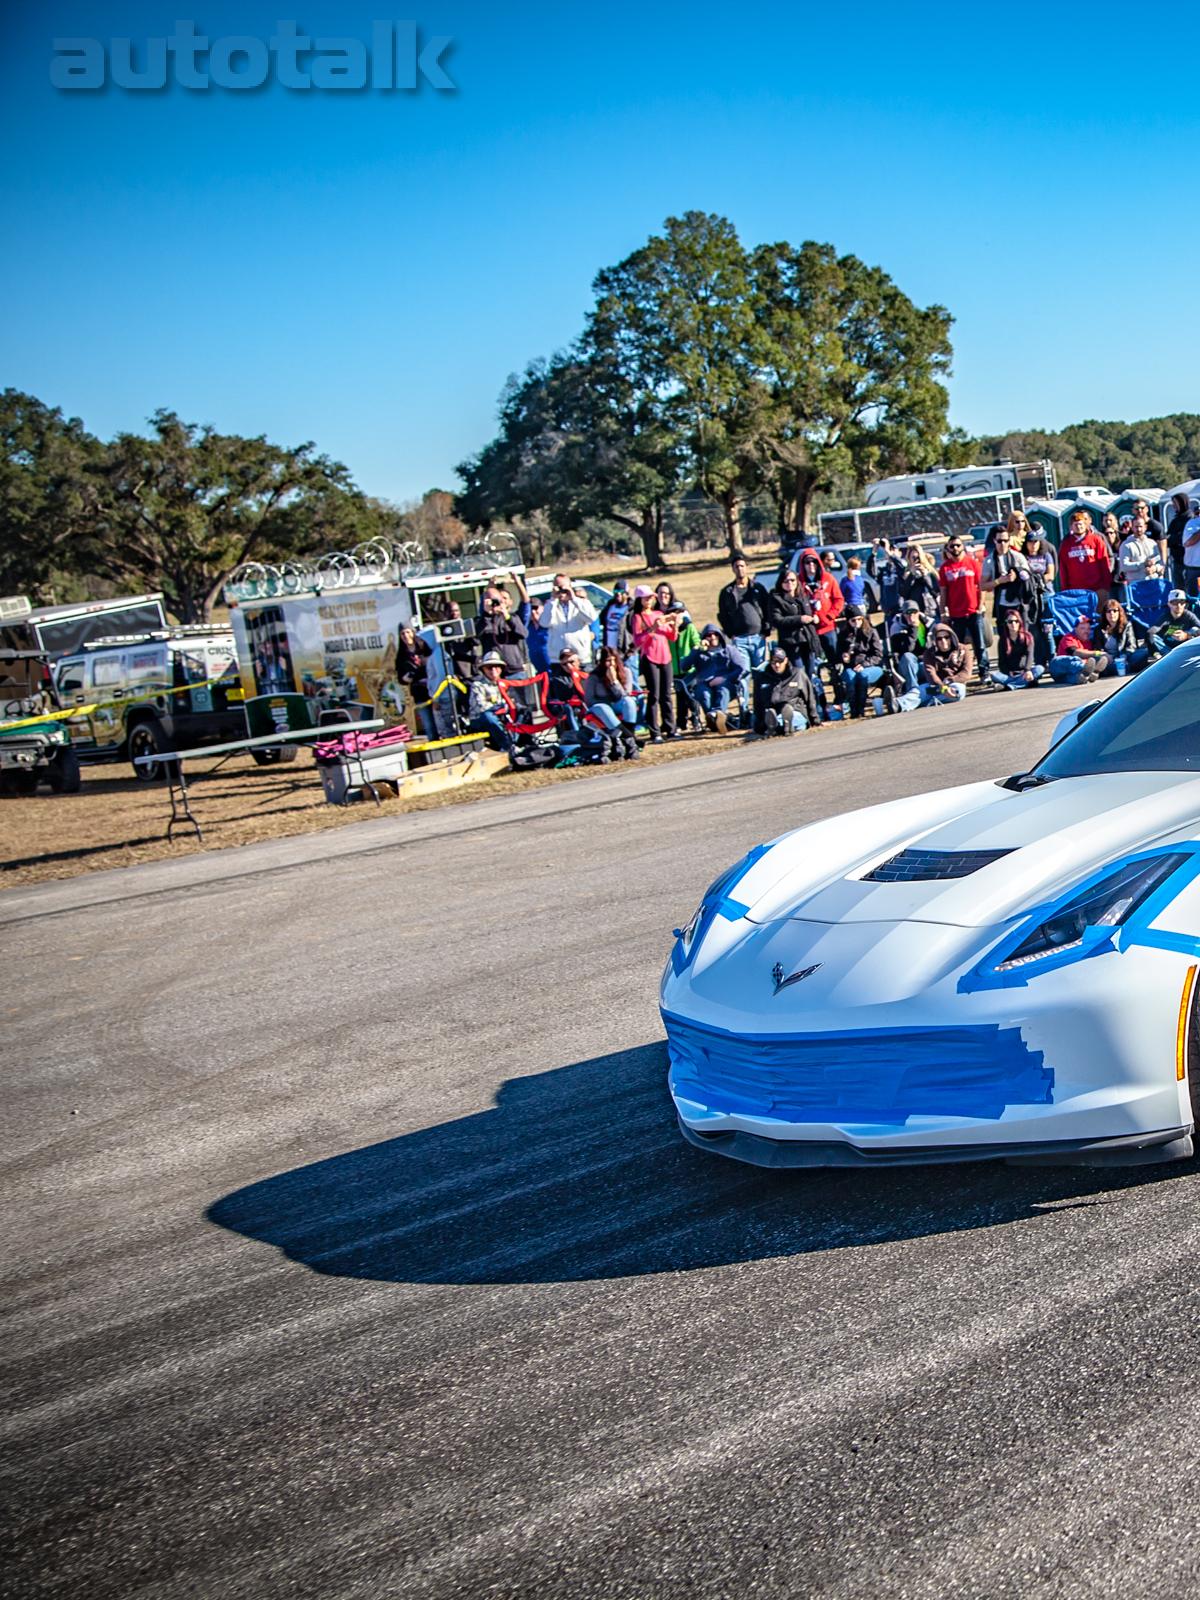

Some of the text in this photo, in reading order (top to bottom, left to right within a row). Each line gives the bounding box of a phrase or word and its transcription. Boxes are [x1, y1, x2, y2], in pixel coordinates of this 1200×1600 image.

[318, 601, 367, 620] REALIZATION
[321, 618, 380, 638] INCARCERATION
[324, 635, 384, 654] MOBILE JAIL CELL
